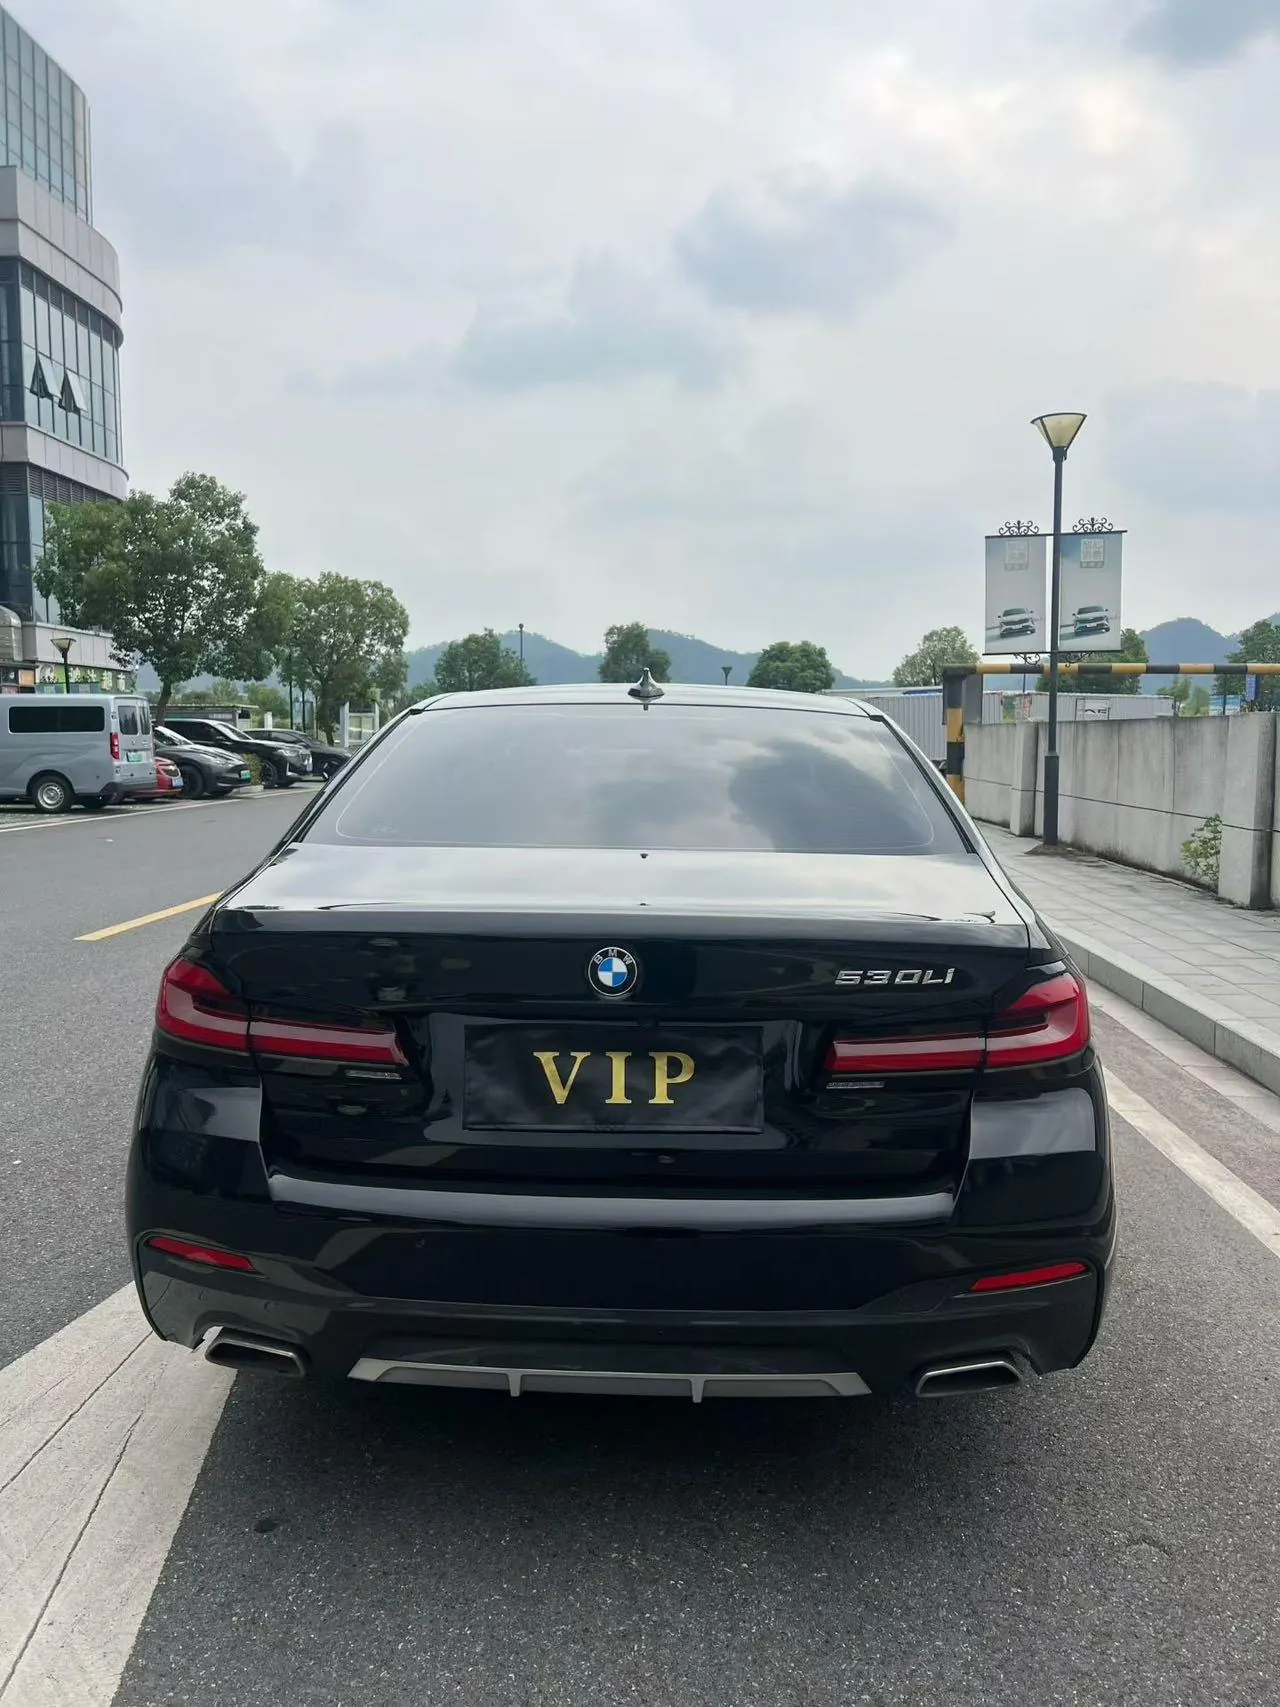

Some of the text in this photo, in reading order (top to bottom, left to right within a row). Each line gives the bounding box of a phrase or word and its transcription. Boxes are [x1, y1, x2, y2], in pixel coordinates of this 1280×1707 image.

[594, 949, 633, 965] BMW
[835, 968, 955, 985] 530Li
[533, 1052, 695, 1104] VIP
